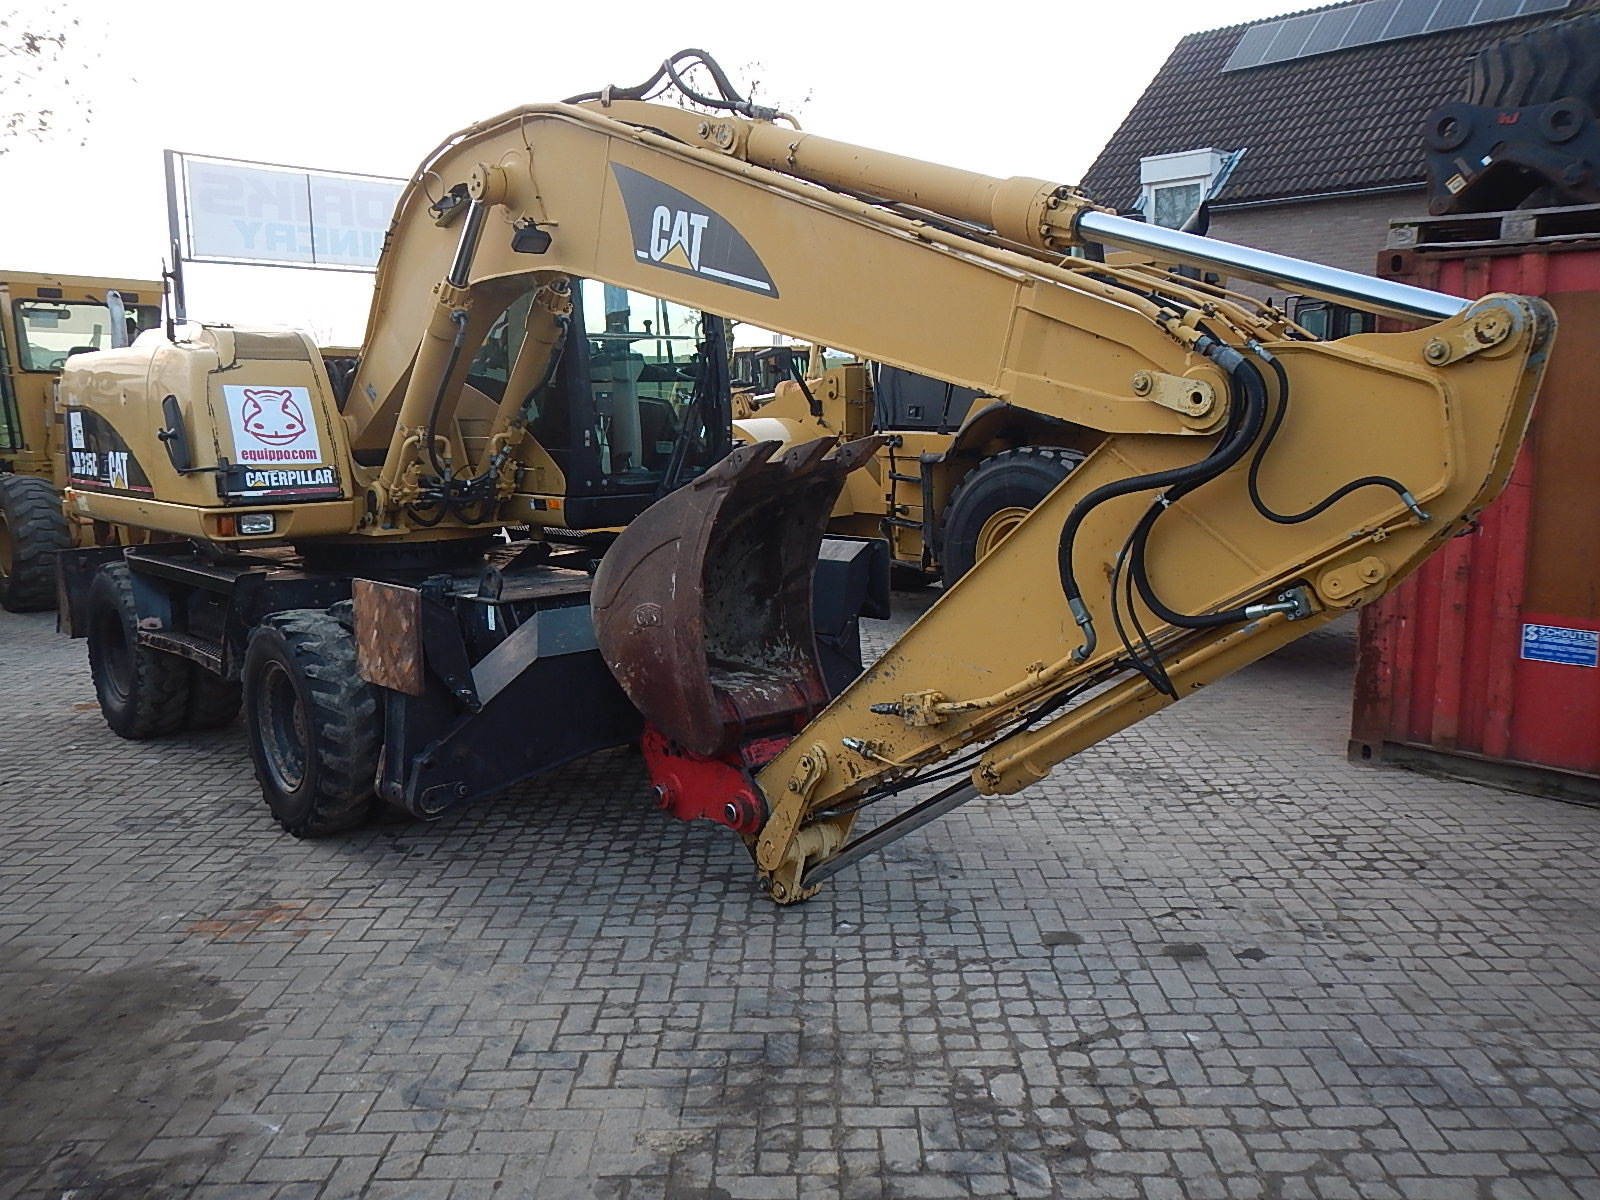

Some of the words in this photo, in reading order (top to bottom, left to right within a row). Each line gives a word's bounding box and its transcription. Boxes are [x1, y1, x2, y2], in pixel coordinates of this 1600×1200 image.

[649, 205, 710, 272] CAT
[240, 447, 318, 462] equippo.com
[108, 450, 129, 490] CAT
[245, 468, 334, 488] CATERPILLAR
